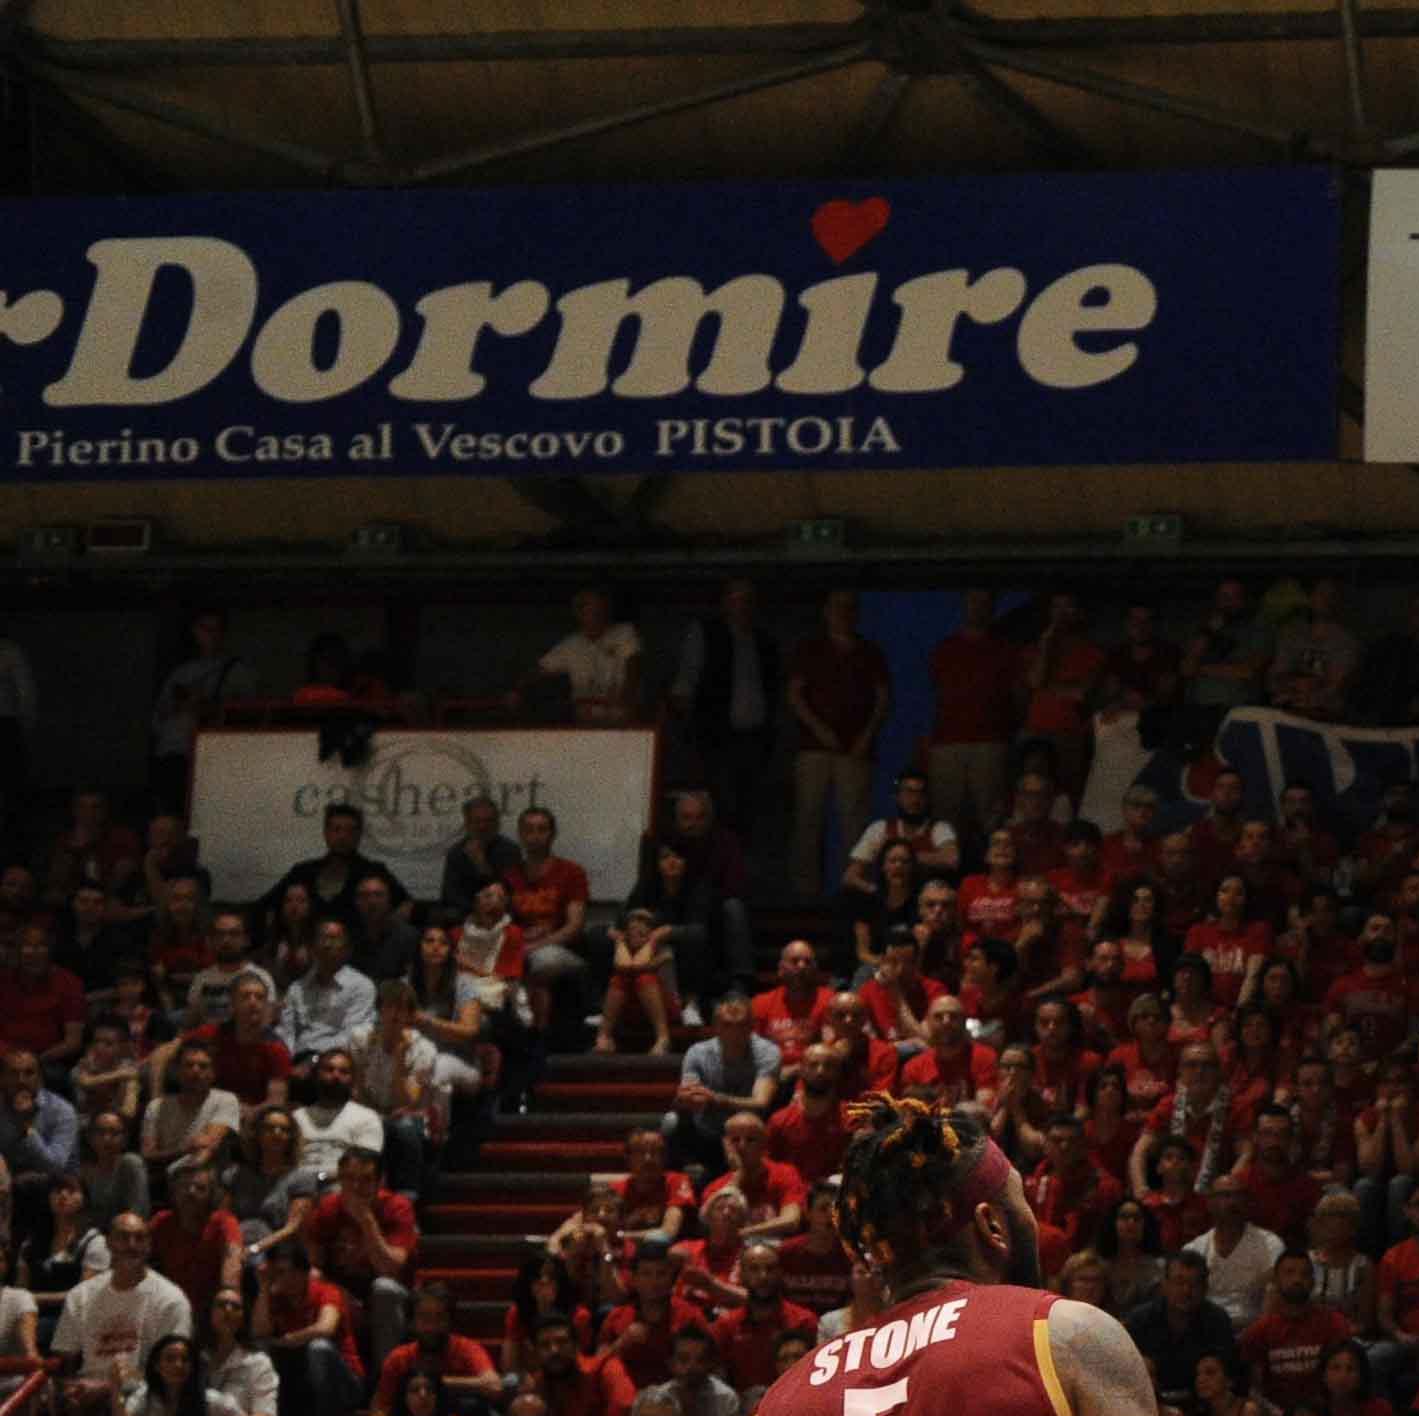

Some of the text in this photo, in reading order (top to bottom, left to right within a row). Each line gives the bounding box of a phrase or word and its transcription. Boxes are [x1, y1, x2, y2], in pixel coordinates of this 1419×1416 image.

[16, 416, 902, 466] Pierino Casa al Vescovo PISTOIA
[809, 1298, 968, 1386] STONE
